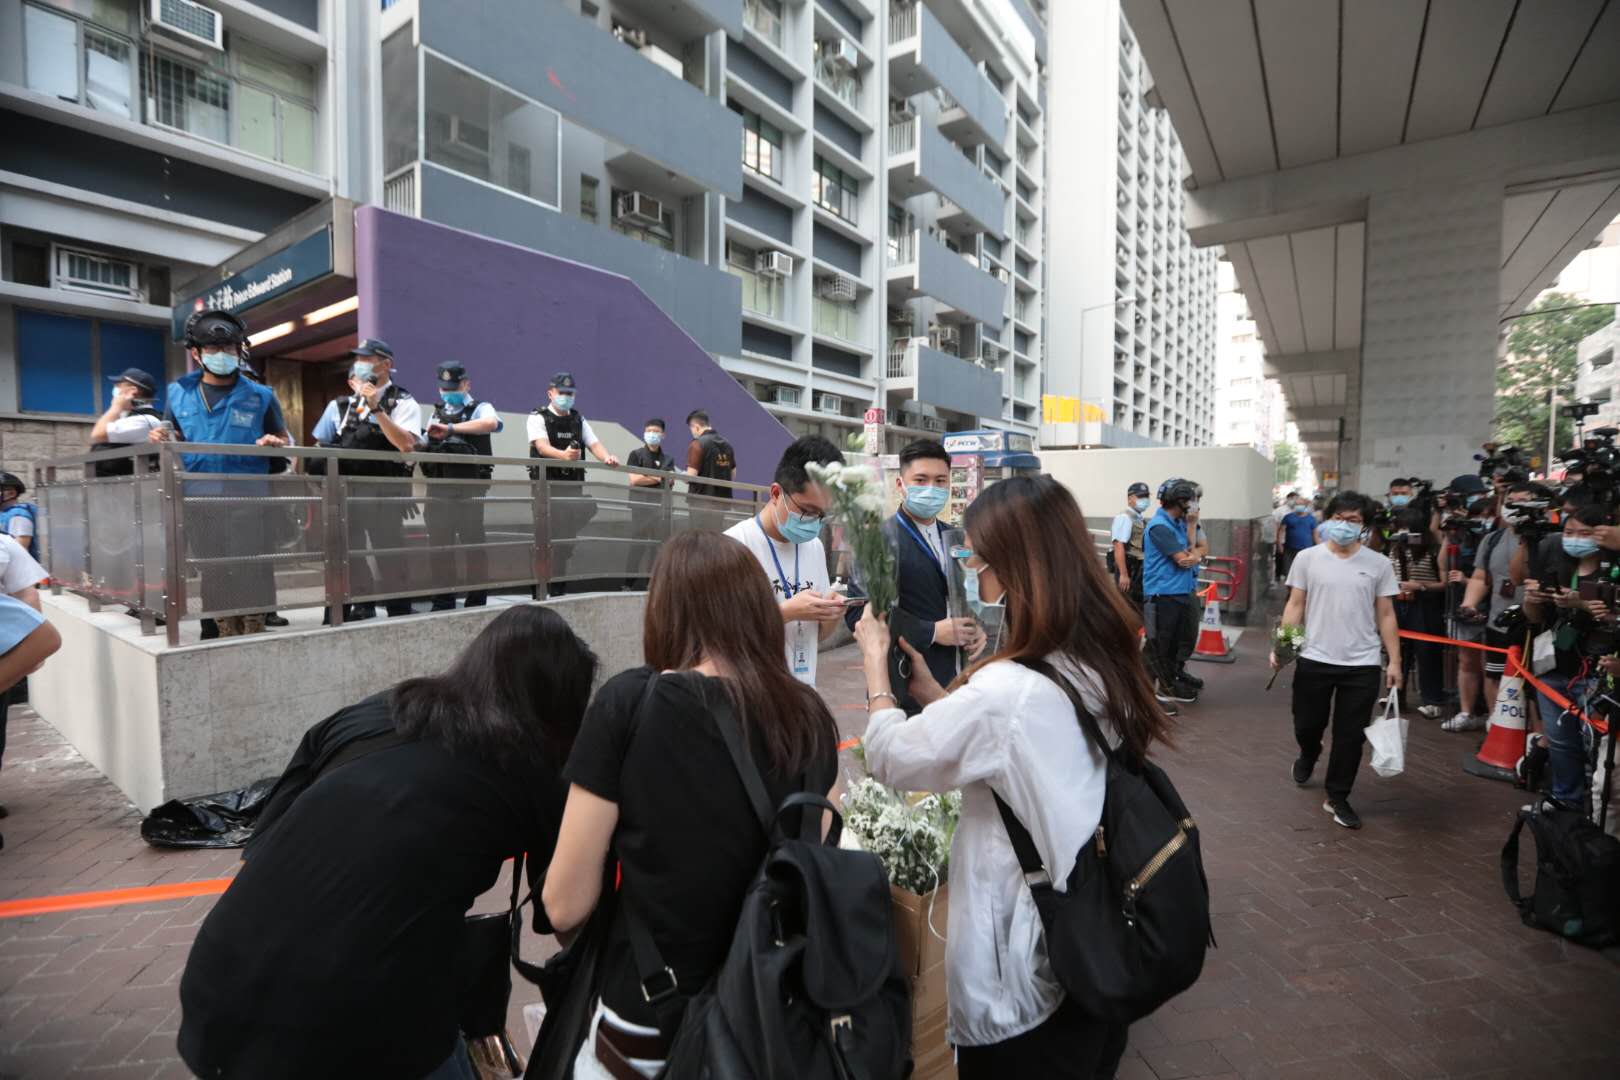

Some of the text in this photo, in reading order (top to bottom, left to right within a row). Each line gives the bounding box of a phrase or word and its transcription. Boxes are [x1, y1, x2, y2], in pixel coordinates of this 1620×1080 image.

[207, 284, 233, 311] 太子站
[233, 268, 292, 307] Prince Edward Station
[1205, 617, 1216, 625] CE
